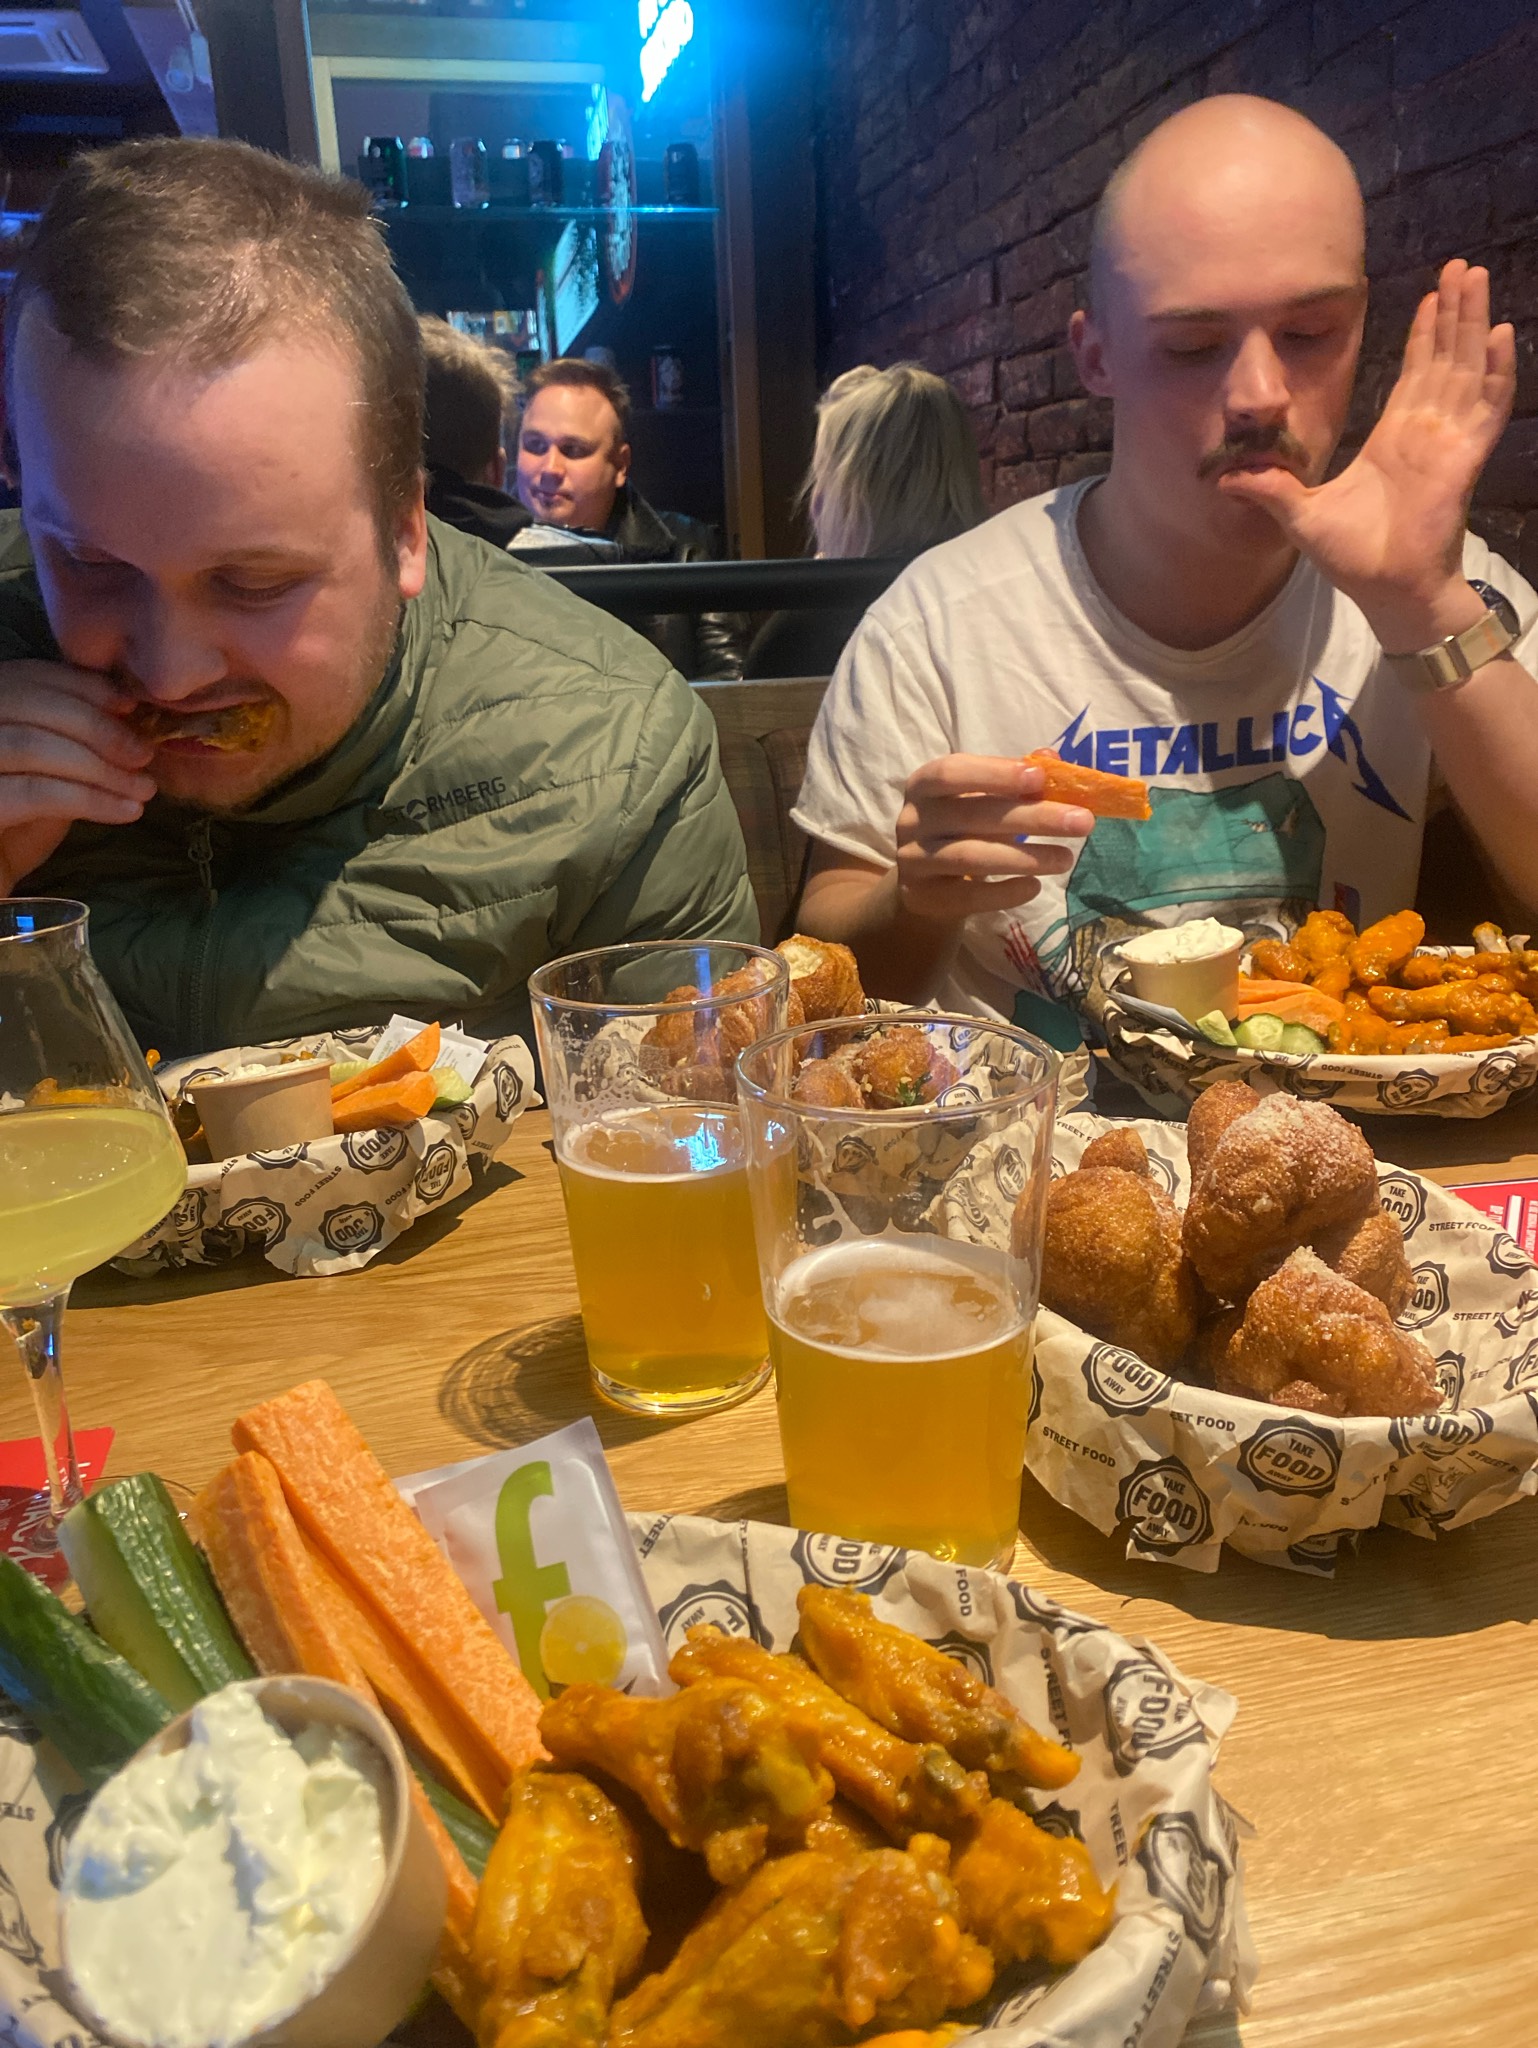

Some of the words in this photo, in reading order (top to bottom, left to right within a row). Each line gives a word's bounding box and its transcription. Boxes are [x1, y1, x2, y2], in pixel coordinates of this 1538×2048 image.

[1053, 675, 1415, 823] METALLICA
[311, 1038, 327, 1055] STRE
[1321, 1063, 1346, 1074] FOOD
[1347, 1066, 1383, 1079] STREET
[1056, 1121, 1085, 1138] TREET
[380, 1145, 396, 1160] TAKE
[314, 1165, 342, 1190] STREET
[294, 1188, 316, 1207] FOOD
[384, 1186, 408, 1206] FOOD
[1390, 1185, 1407, 1198] TAKE
[243, 1207, 278, 1231] FOO
[1429, 1221, 1464, 1232] STREET
[1411, 1288, 1436, 1311] OD
[1401, 1309, 1417, 1321] WAY
[1452, 1312, 1492, 1321] STREET
[1100, 1348, 1158, 1392] FOOD
[1103, 1376, 1126, 1396] AWAY
[1170, 1411, 1194, 1424] EET
[1196, 1415, 1236, 1432] FOOD
[1042, 1426, 1080, 1452] STREET
[1082, 1446, 1116, 1468] FOOD
[1289, 1438, 1316, 1459] TAKE
[1255, 1444, 1326, 1481] FOOD
[1467, 1450, 1513, 1469] STREET
[1163, 1476, 1186, 1495] TAKE
[1266, 1469, 1294, 1482] AWAY
[1133, 1484, 1198, 1531] FOOD
[639, 1514, 673, 1559] TREET
[1146, 1522, 1171, 1538] AWAY
[832, 1537, 863, 1574] OD
[956, 1568, 972, 1616] FOOD
[1110, 1799, 1128, 1867] TREET
[1141, 1930, 1181, 2023] STREET
